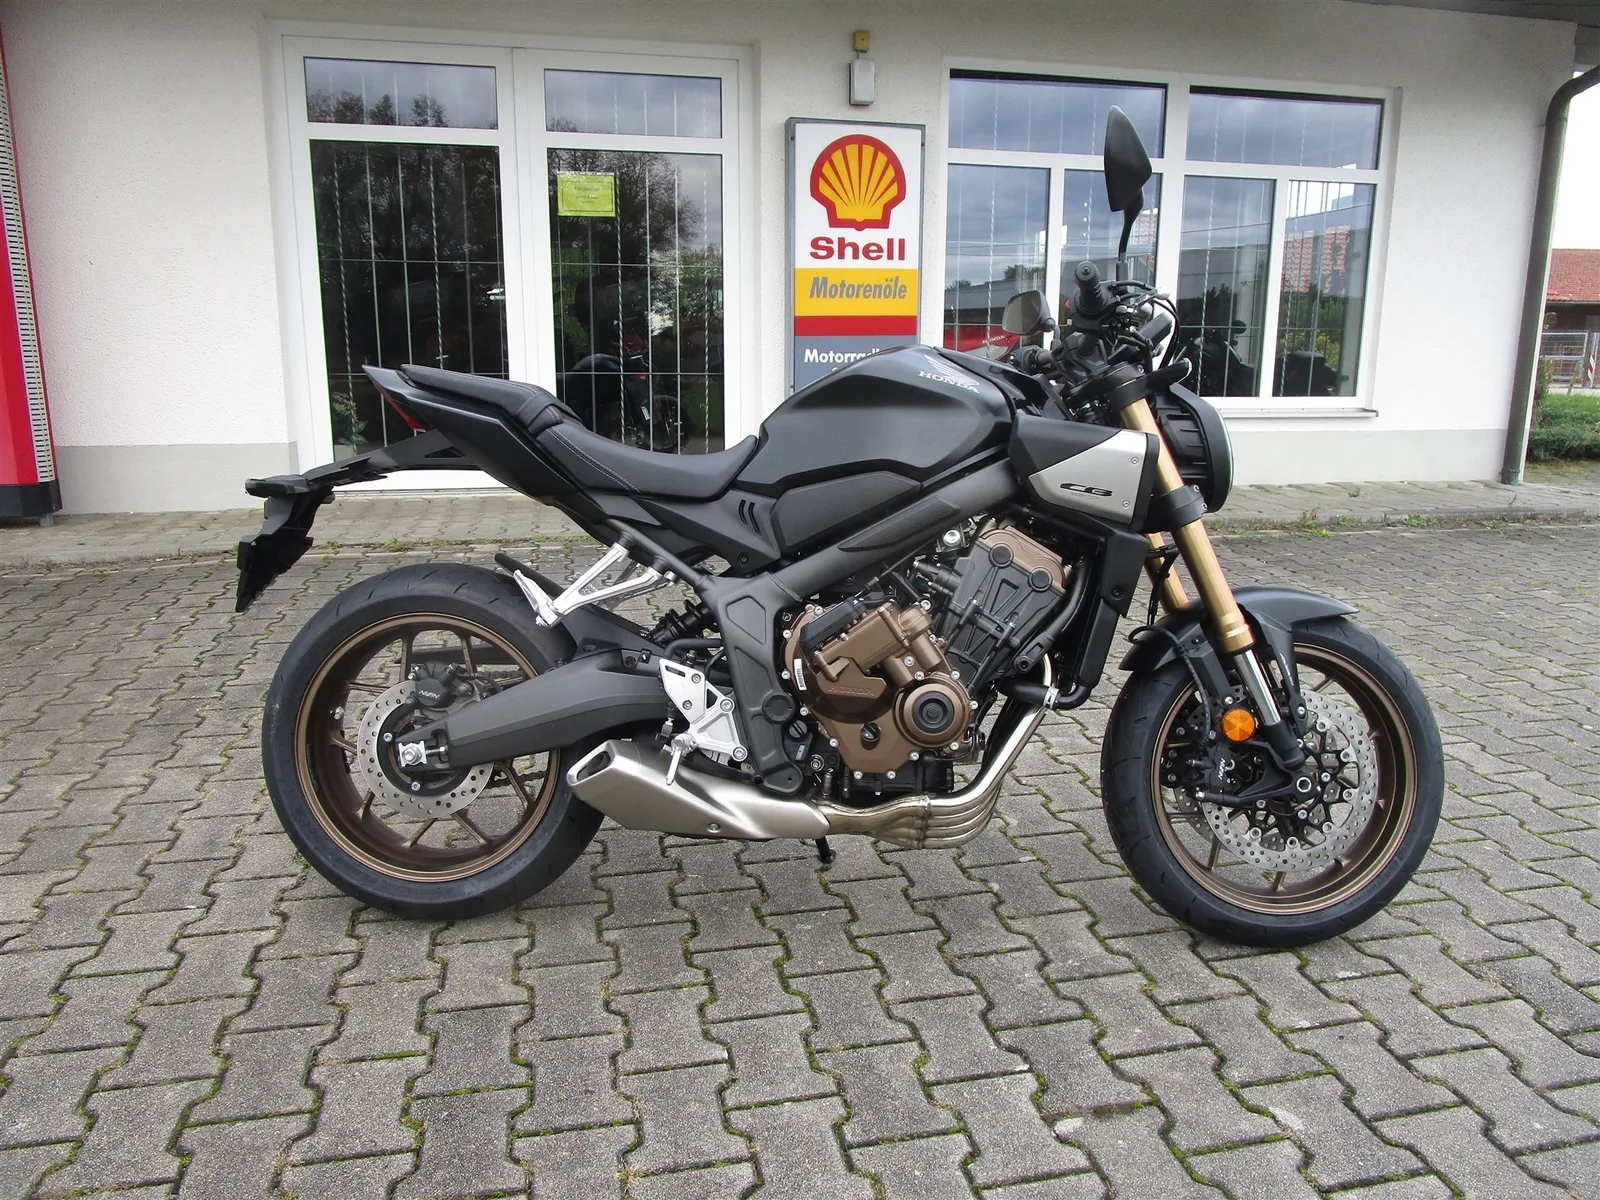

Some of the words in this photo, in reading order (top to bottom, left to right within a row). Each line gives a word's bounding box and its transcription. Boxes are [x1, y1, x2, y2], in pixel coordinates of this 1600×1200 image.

[809, 236, 905, 261] Shell
[809, 275, 907, 300] Motorenöle
[918, 370, 980, 394] HONDA
[1060, 482, 1113, 497] CB
[827, 685, 875, 697] HONDA
